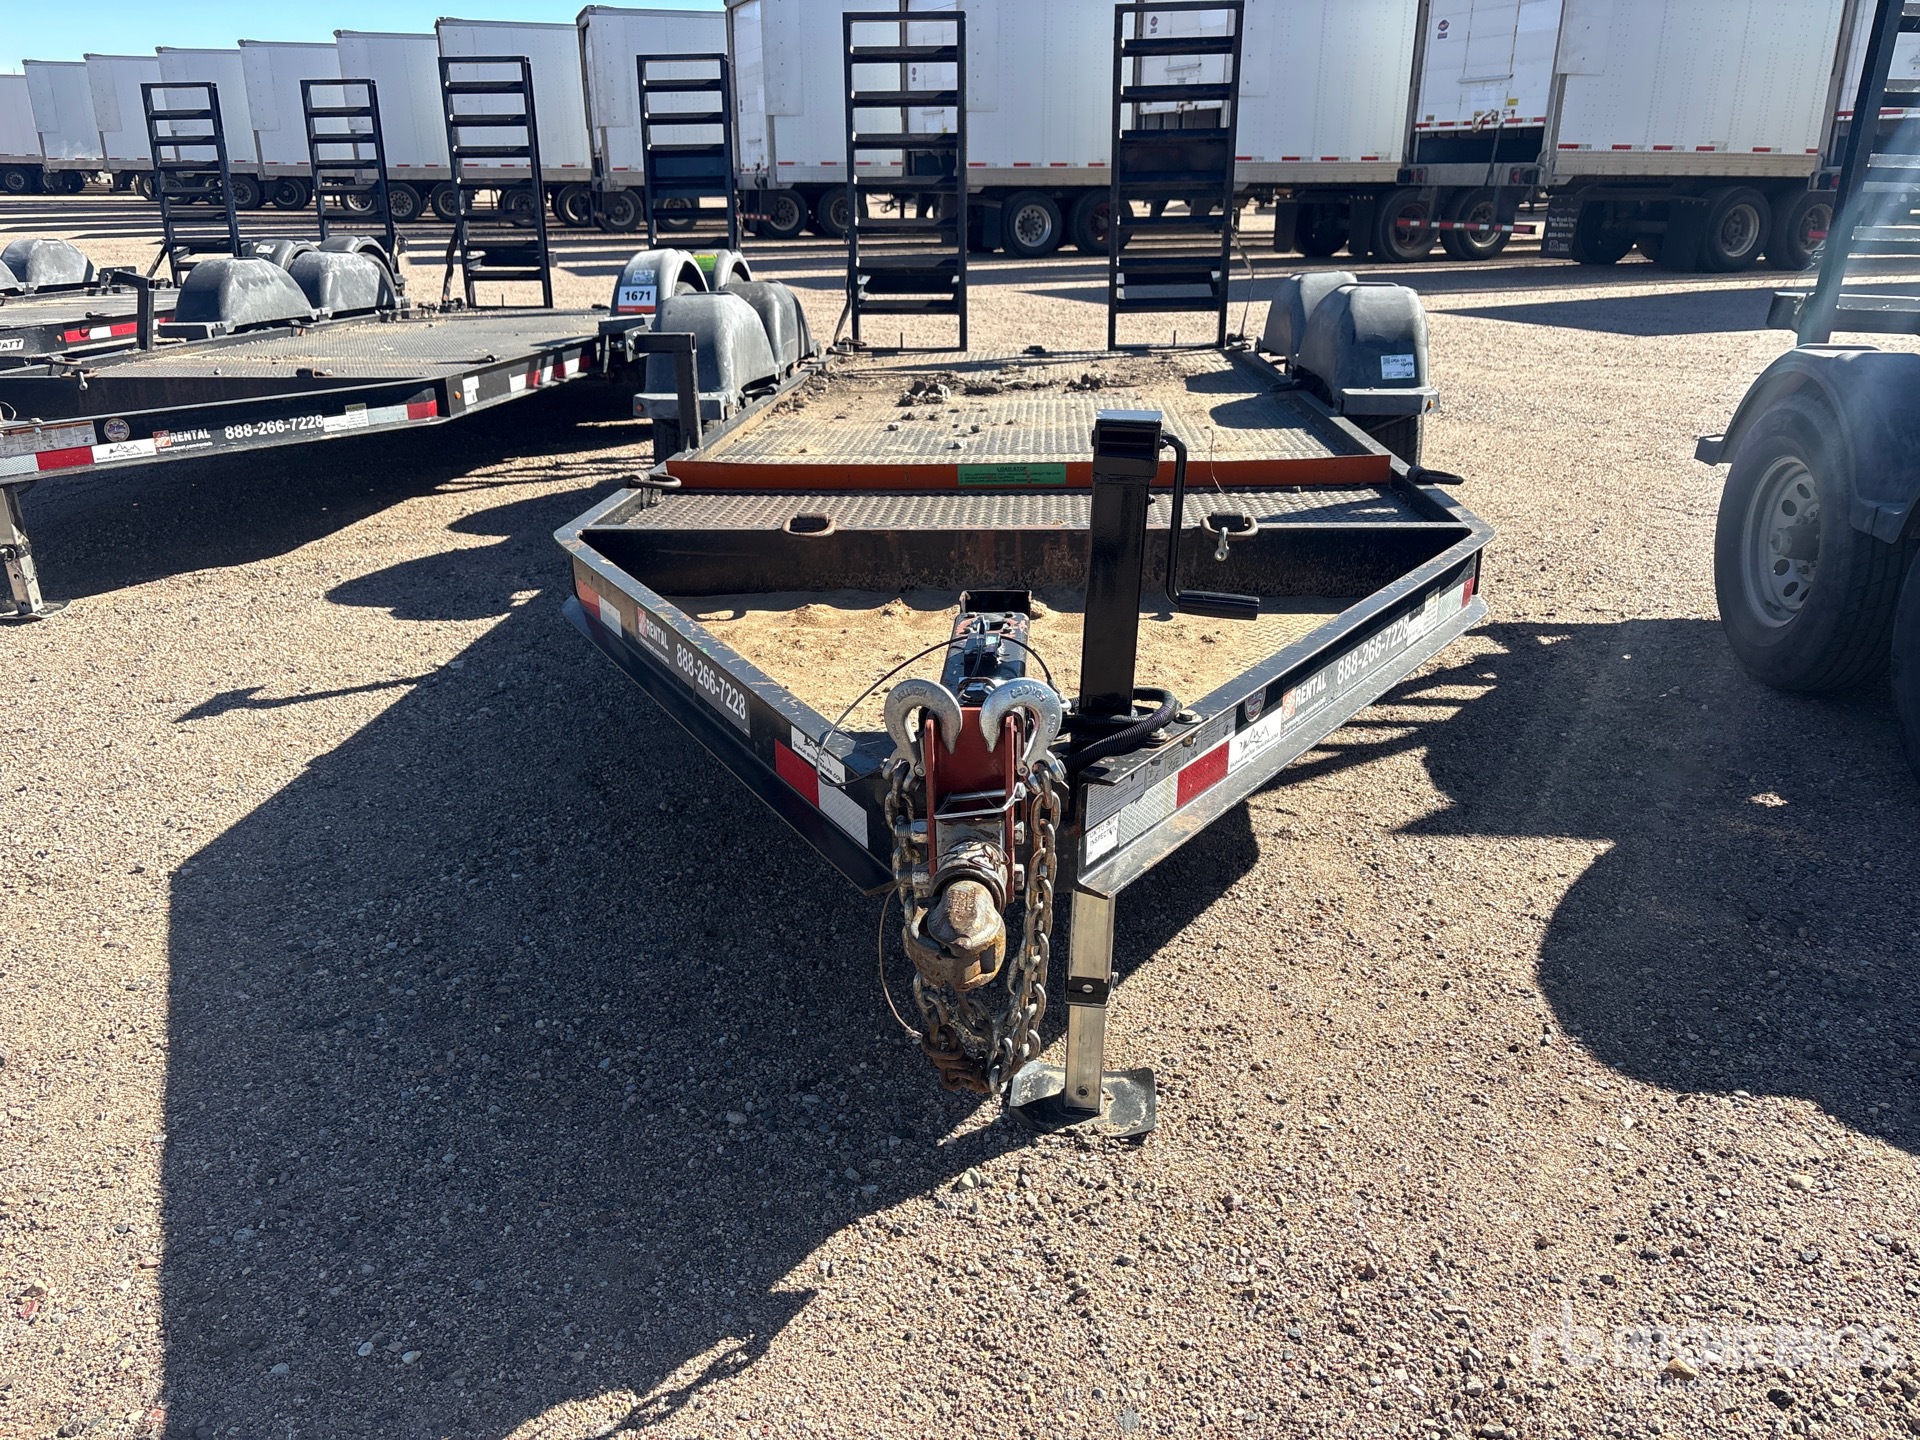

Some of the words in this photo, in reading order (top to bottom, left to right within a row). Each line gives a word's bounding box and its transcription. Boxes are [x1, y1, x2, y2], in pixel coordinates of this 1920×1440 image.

[625, 290, 651, 301] 1671
[170, 428, 211, 443] RENTAL
[224, 414, 324, 440] 888-266-7228
[646, 618, 669, 651] RENTAL
[676, 643, 746, 720] 888-266-7228
[1295, 671, 1327, 709] RENTAL
[1337, 615, 1410, 685] 888-266-7228
